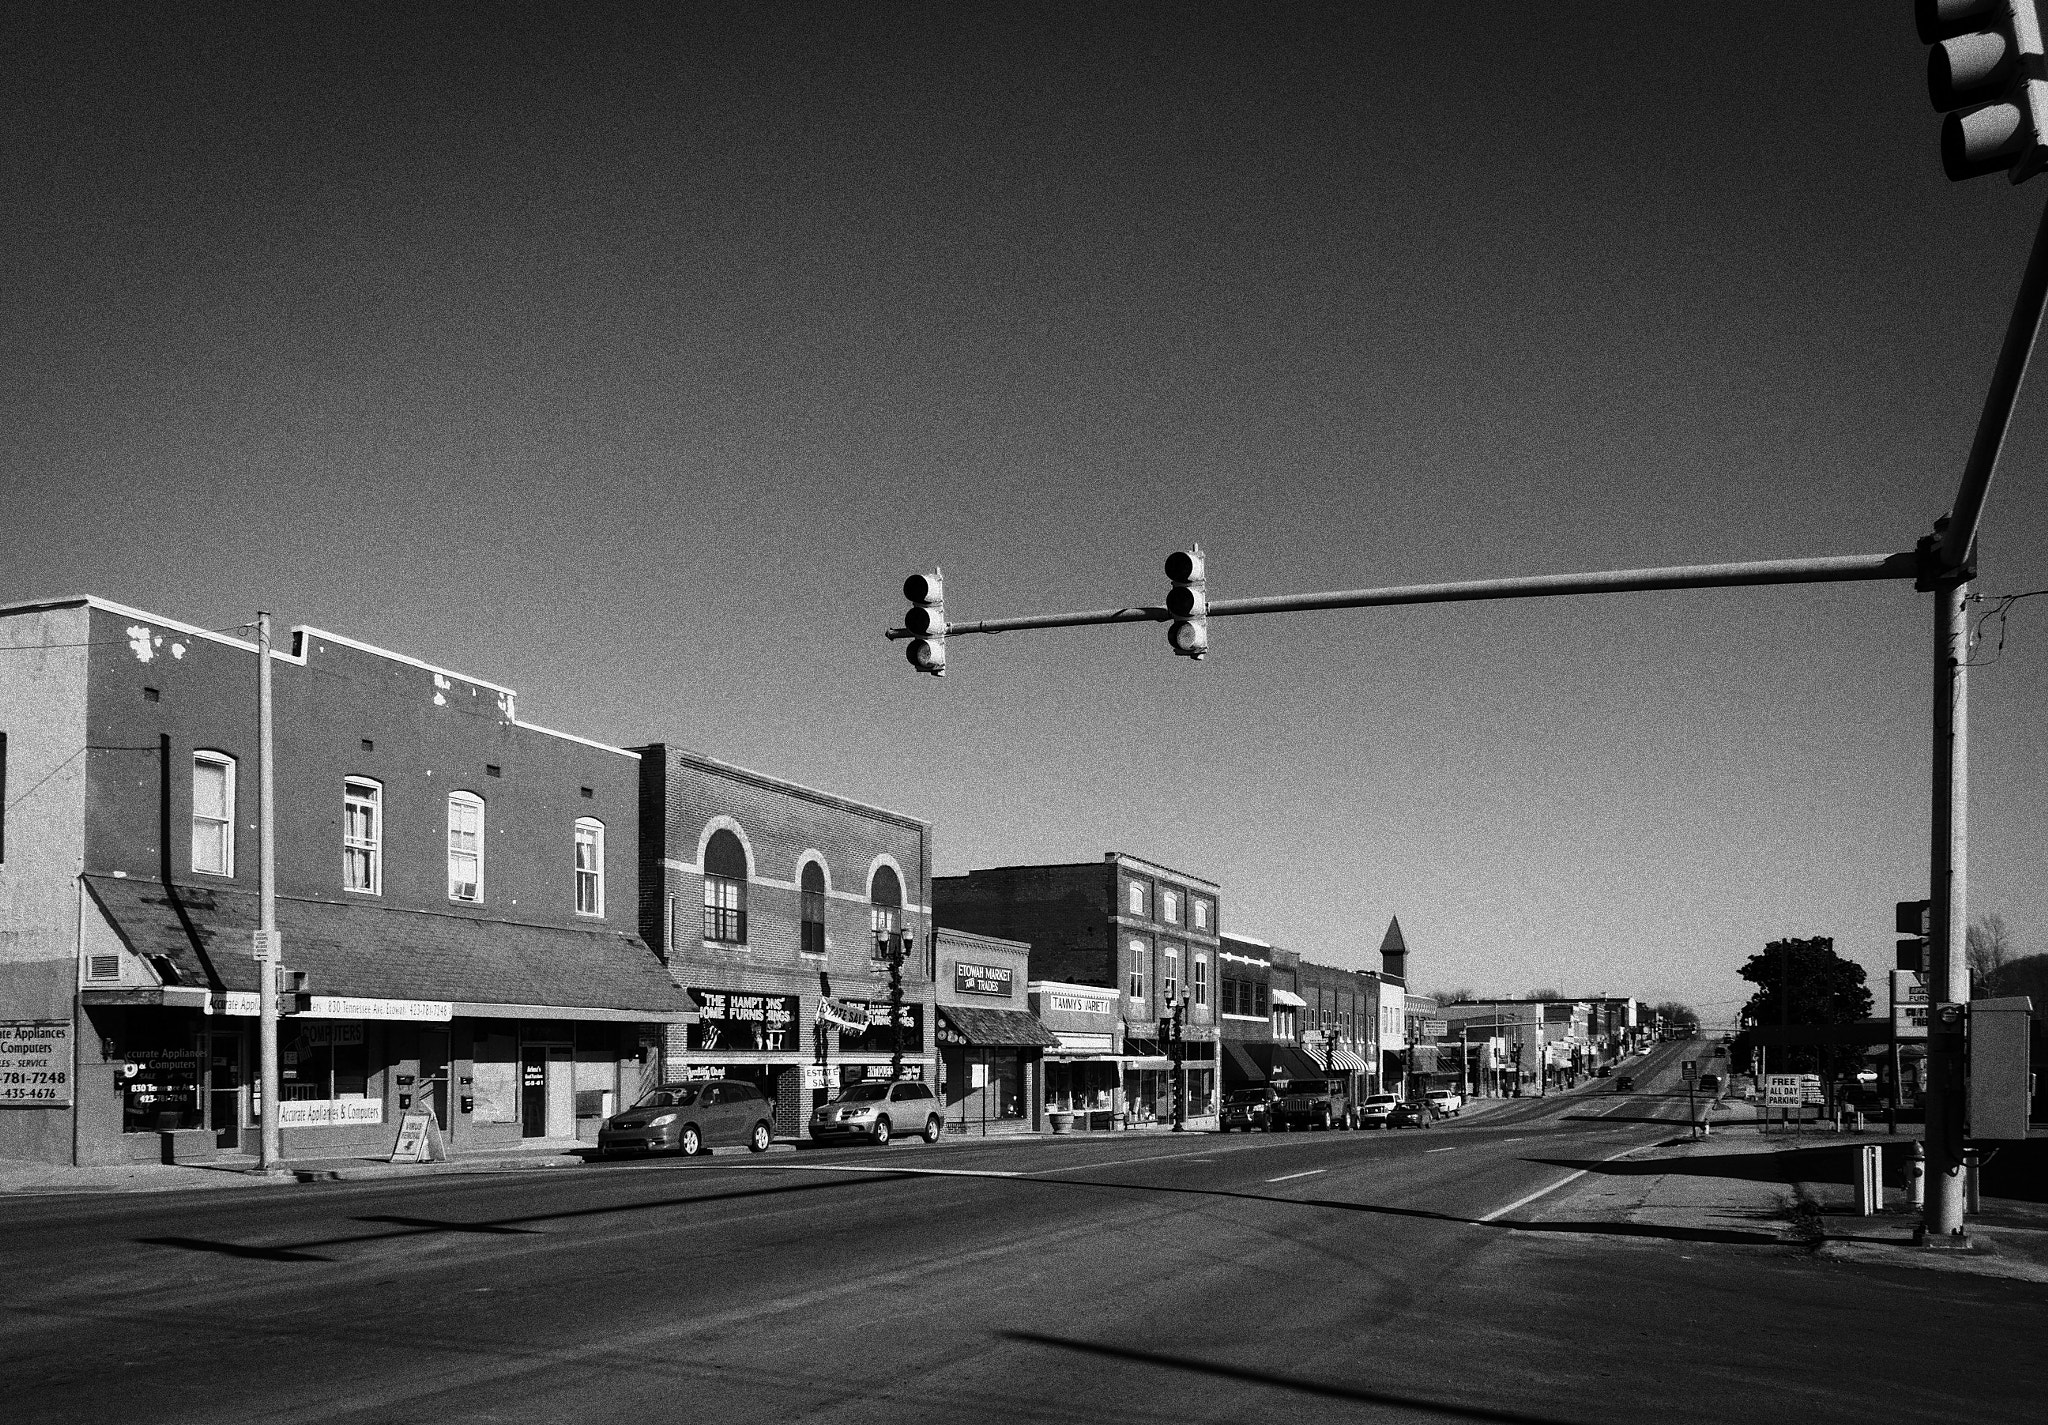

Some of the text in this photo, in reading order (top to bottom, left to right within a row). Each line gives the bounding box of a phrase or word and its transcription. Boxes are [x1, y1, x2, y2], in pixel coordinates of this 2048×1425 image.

[958, 964, 1011, 981] ETOWAH MARKET
[977, 979, 999, 992] TRADES
[328, 1000, 341, 1013] 830
[343, 1000, 371, 1014] Tennessee
[848, 1011, 868, 1025] SALE
[15, 1026, 66, 1041] Appliances
[302, 1024, 362, 1042] COMPUTERS
[1, 1041, 52, 1055] Computers
[18, 1059, 48, 1068] SERVICE
[148, 1059, 196, 1071] Computers
[806, 1068, 840, 1077] ESTATE
[1772, 1078, 1796, 1086] FREE
[1770, 1087, 1798, 1095] ALL DAY
[1769, 1096, 1799, 1105] PARKING
[280, 1106, 306, 1122] Accurate
[347, 1103, 379, 1120] Computers
